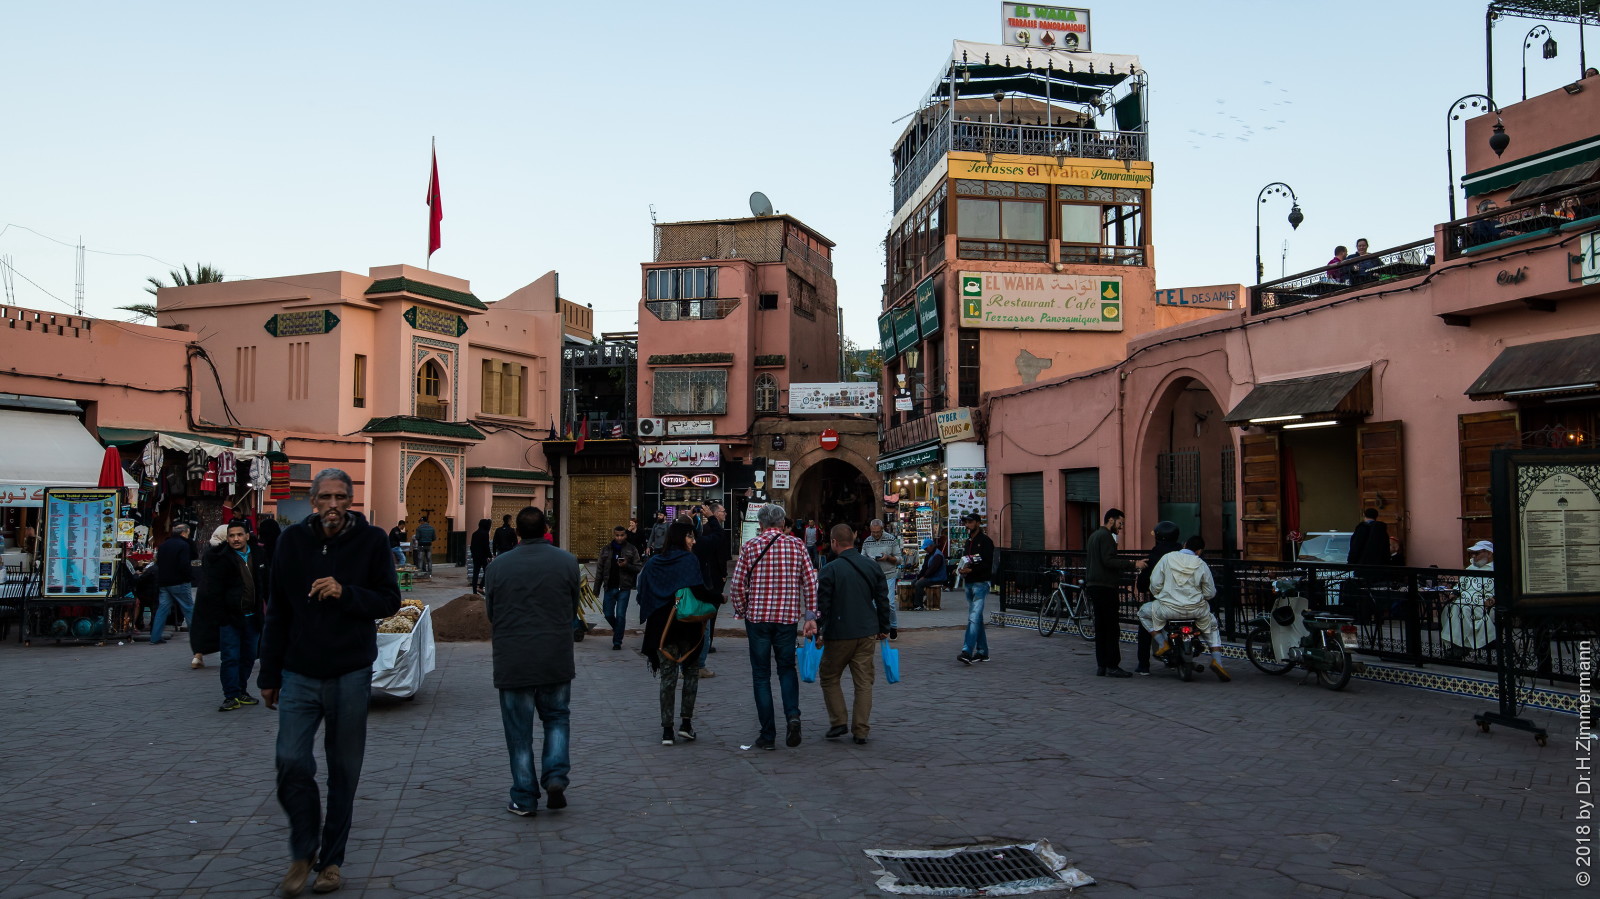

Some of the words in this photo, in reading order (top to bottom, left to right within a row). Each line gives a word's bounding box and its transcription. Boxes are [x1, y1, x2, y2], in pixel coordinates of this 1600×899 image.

[1015, 5, 1031, 18] EL
[1034, 7, 1077, 21] WAHA
[1008, 18, 1037, 28] TERRASSE
[1039, 20, 1087, 33] PANORAMIQUE
[967, 159, 1024, 175] Terrasses
[1027, 166, 1040, 177] el
[1044, 164, 1090, 180] Waha
[1090, 169, 1152, 184] Panoramiques
[985, 275, 1000, 291] EL
[1004, 276, 1045, 291] WAHA
[986, 294, 1056, 309] Restaurant
[1064, 296, 1096, 311] Café
[1191, 293, 1211, 304] DES
[1212, 290, 1236, 302] AMIS
[985, 311, 1035, 323] Terrasses
[1039, 312, 1100, 326] Panoramiques
[938, 412, 958, 424] CYBER
[944, 423, 963, 436] BOOKS
[663, 476, 686, 484] OPTIQUE
